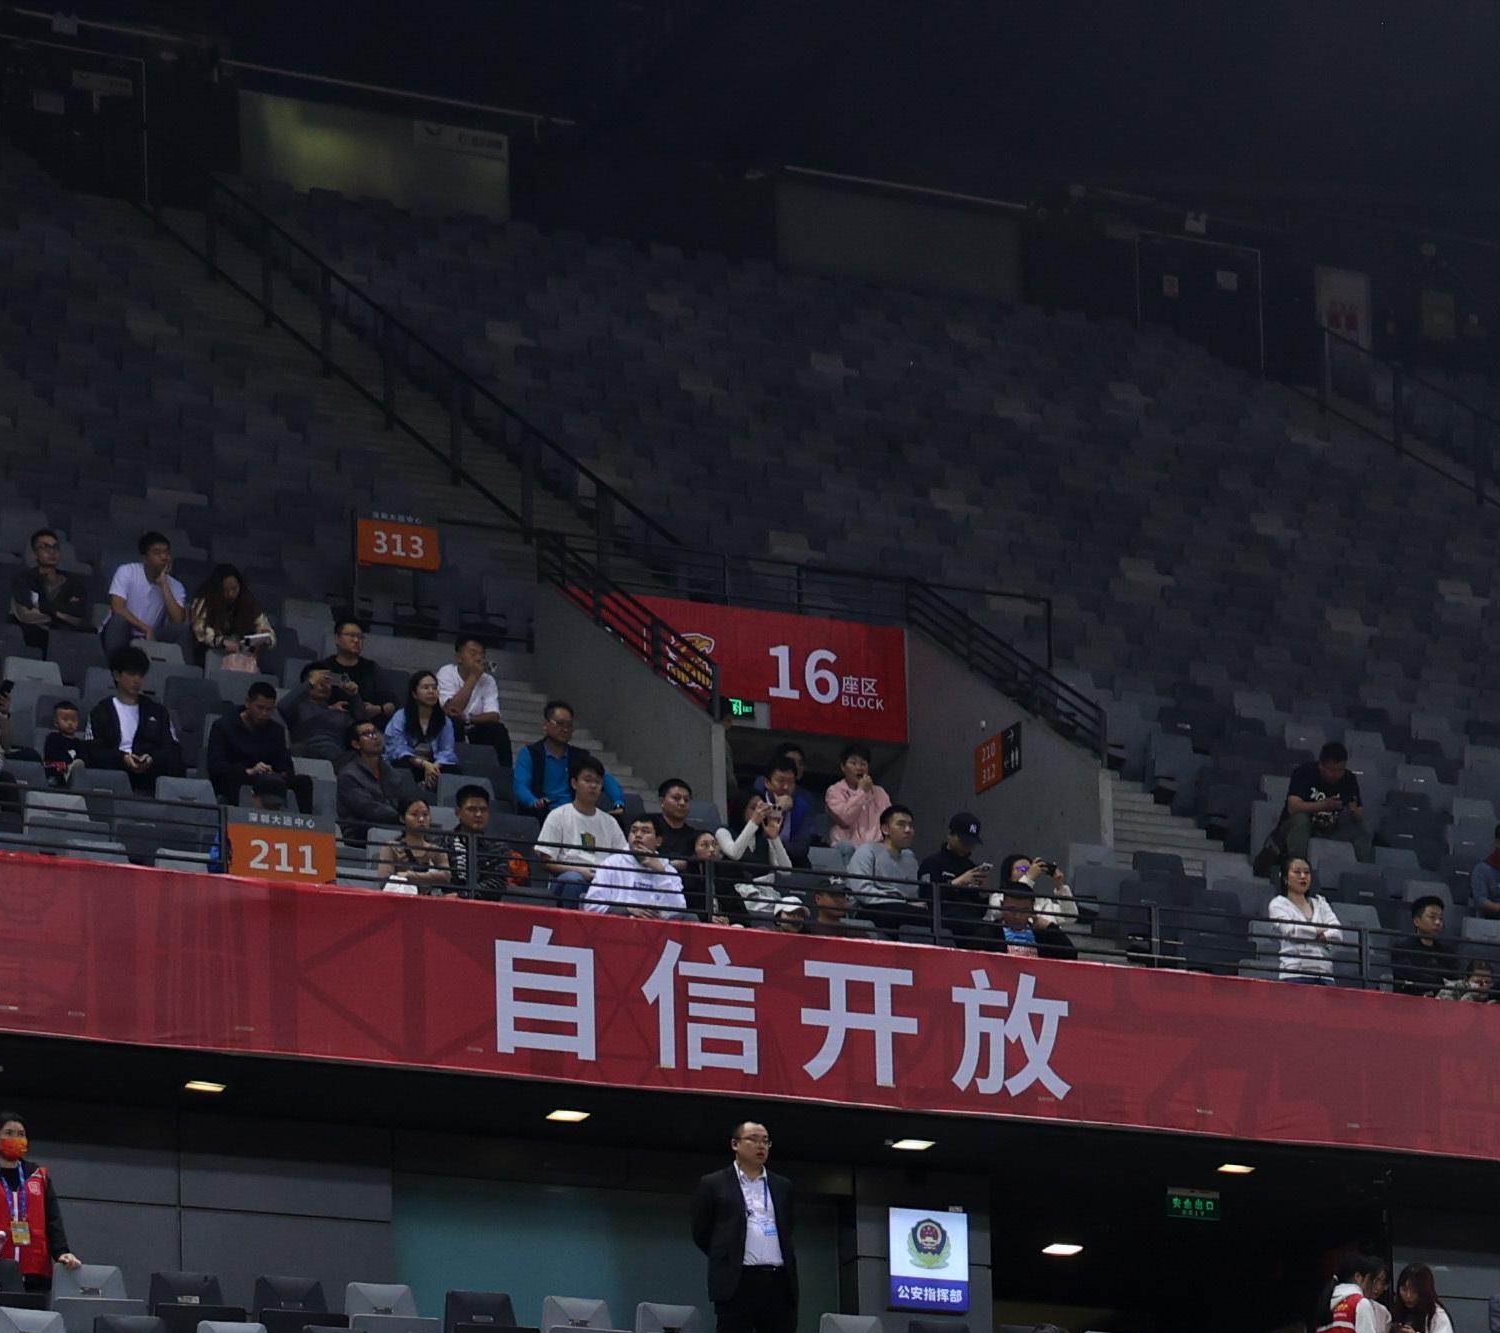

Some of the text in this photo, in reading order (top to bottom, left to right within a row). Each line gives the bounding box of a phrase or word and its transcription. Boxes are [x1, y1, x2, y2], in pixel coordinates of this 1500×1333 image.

[373, 530, 424, 560] 313
[768, 645, 839, 704] 16
[842, 675, 879, 697] 座区
[841, 695, 884, 711] BLOCK
[249, 838, 319, 876] 211
[494, 926, 1071, 1101] 自信开放
[897, 1284, 963, 1304] 公安指挥部
